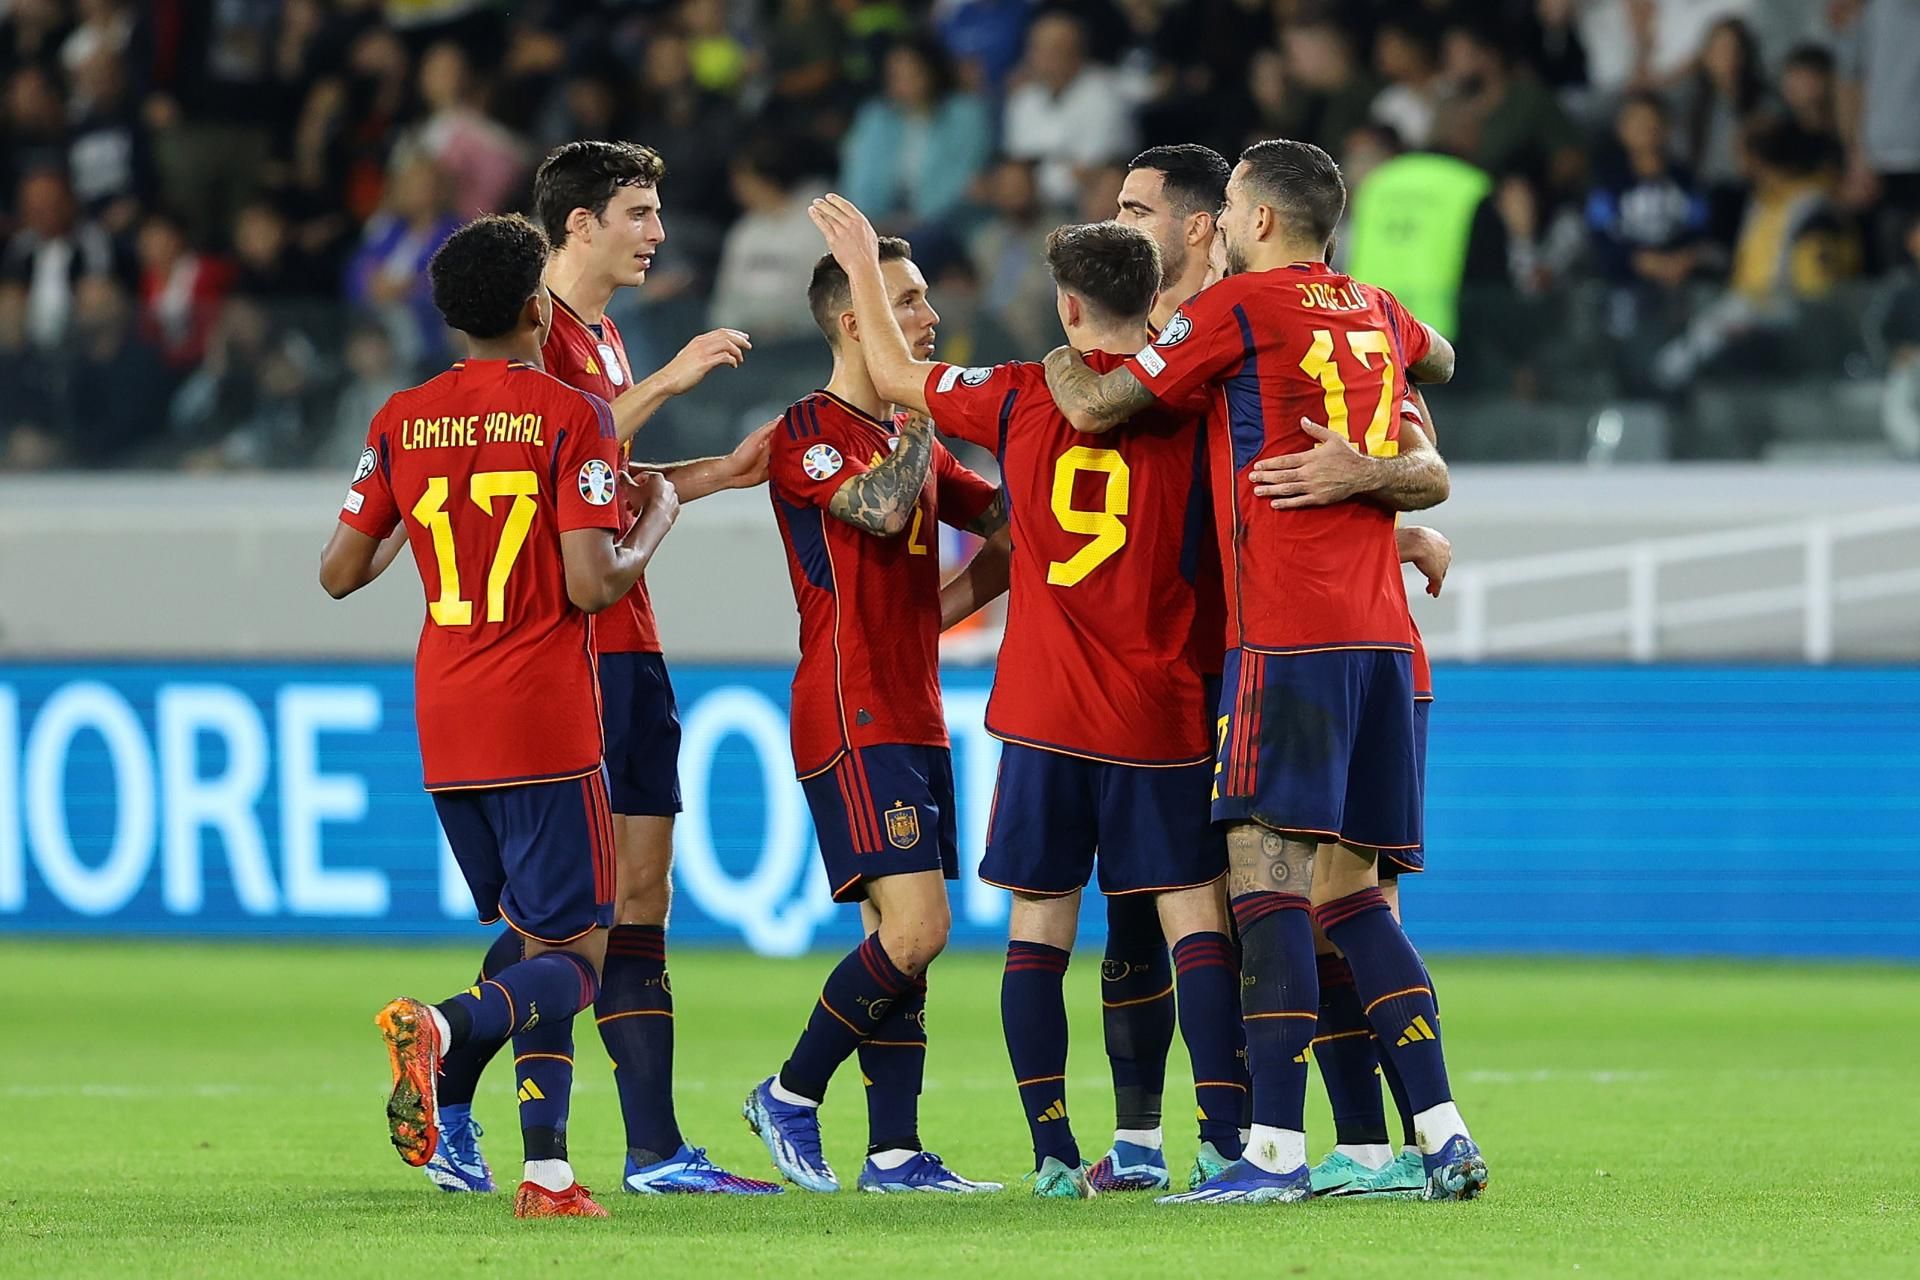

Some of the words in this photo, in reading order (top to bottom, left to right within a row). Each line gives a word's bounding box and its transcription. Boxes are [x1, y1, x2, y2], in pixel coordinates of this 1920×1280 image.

[1295, 282, 1368, 311] JOSELU
[402, 415, 479, 451] LAMINE
[484, 411, 545, 447] YAMAL
[1298, 329, 1399, 458] 12
[411, 470, 539, 627] 17
[1047, 445, 1130, 587] 9
[0, 680, 391, 918] ORE
